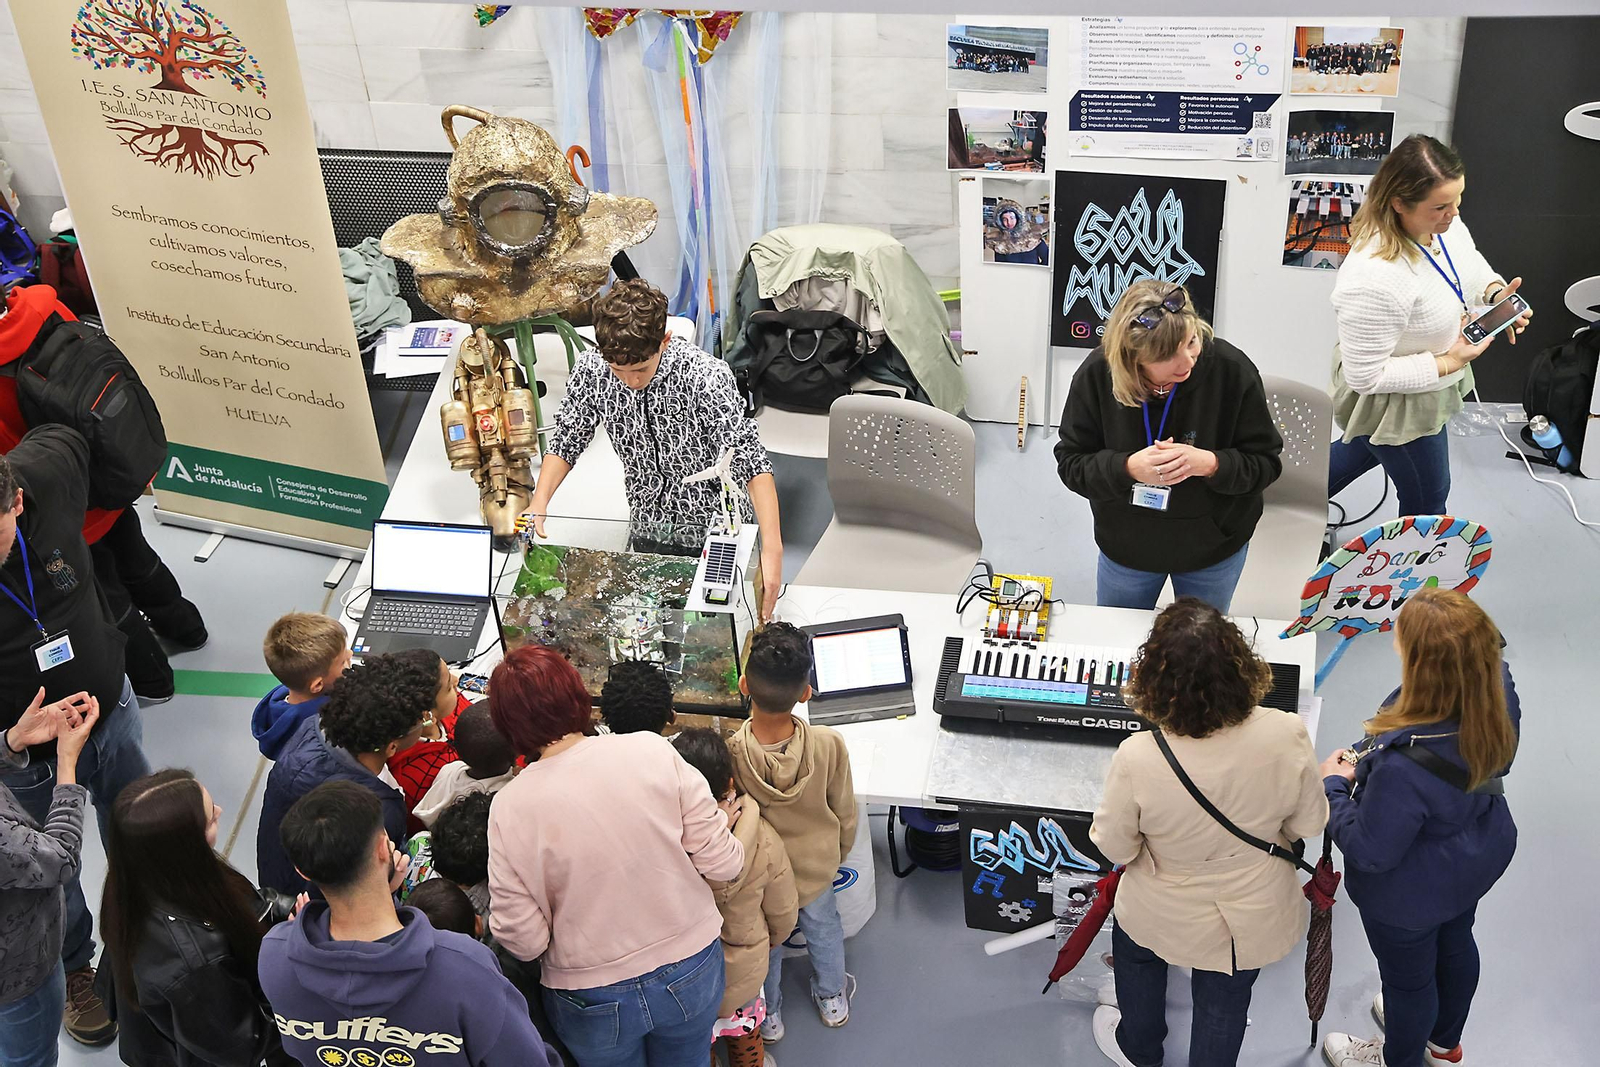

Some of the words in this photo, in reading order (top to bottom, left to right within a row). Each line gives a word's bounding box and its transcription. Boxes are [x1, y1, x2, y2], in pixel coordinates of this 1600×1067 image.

[81, 78, 130, 100] I.E.S.
[135, 88, 174, 106] SAN
[180, 95, 272, 121] ANTONIO
[100, 100, 154, 120] Bollullos
[156, 110, 177, 124] Par
[180, 111, 200, 126] del
[202, 117, 263, 137] Condado
[111, 204, 198, 231] Sembramos
[201, 222, 316, 253] conocimientos,
[1074, 187, 1206, 276] SOUL
[149, 233, 227, 259] cultivamos
[229, 246, 288, 272] valores,
[150, 258, 243, 285] cosechamos
[245, 269, 297, 294] futuro.
[126, 306, 180, 329] Instituto
[182, 315, 201, 331] de
[202, 319, 274, 344] Educación
[276, 333, 351, 358] Secundaria
[200, 344, 228, 360] San
[232, 350, 290, 372] Antonio
[158, 364, 220, 387] Bollullos
[222, 376, 247, 392] Par
[250, 378, 273, 397] del
[276, 386, 345, 411] Condado
[225, 405, 291, 429] HUELVA
[193, 462, 224, 477] Junta
[195, 473, 209, 483] de
[210, 475, 263, 494] Andalucía
[276, 476, 316, 494] Consejería
[317, 484, 327, 492] de
[328, 485, 368, 502] Desarrollo
[277, 485, 314, 498] Educativo
[279, 493, 320, 507] Formación
[321, 498, 362, 515] Profesional
[1081, 717, 1141, 731] CASIO
[273, 1012, 464, 1054] scuffers
